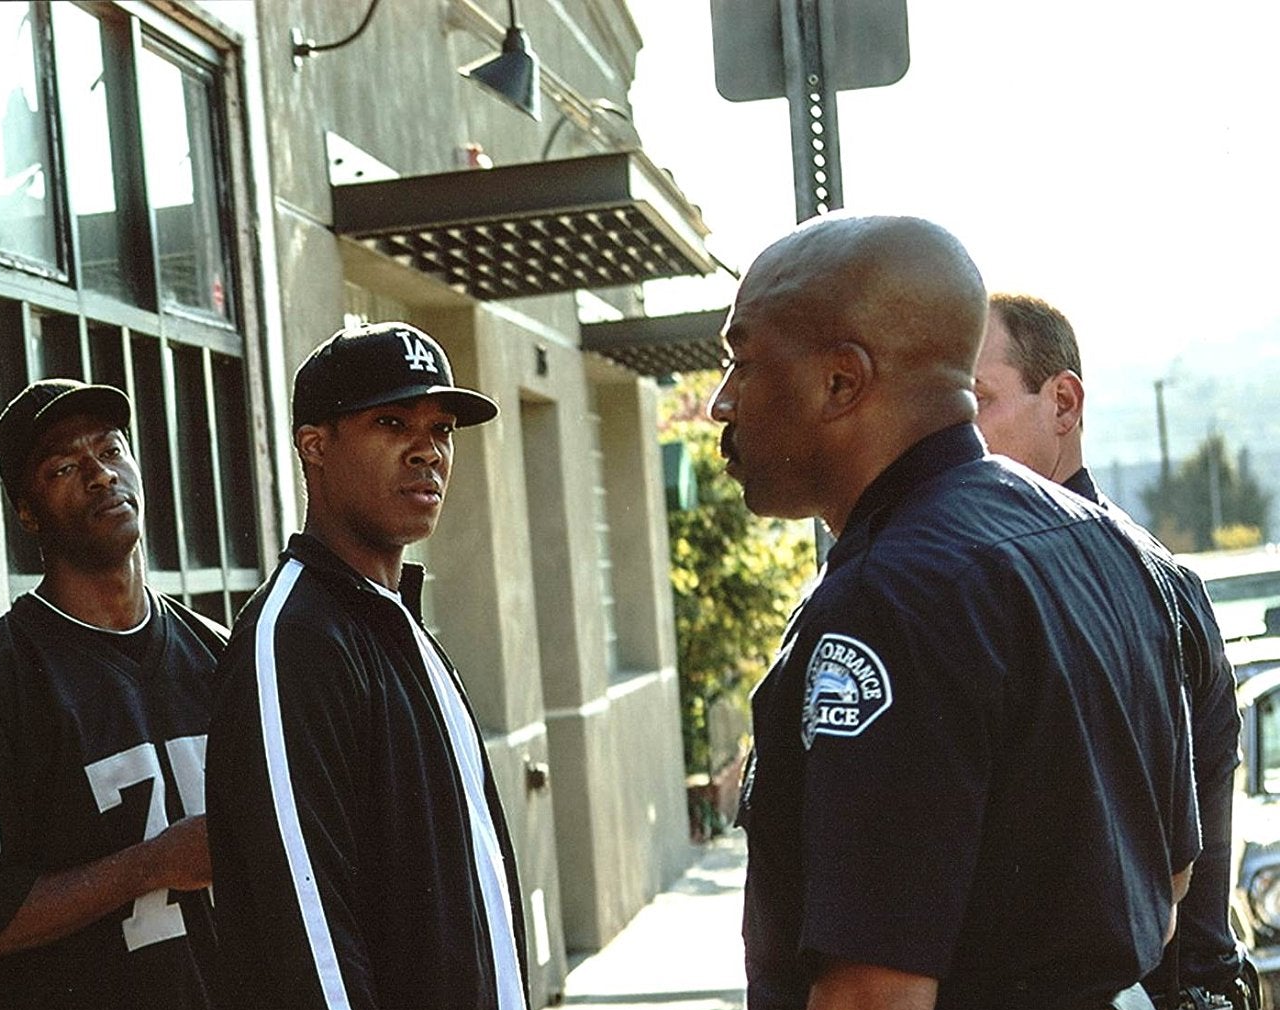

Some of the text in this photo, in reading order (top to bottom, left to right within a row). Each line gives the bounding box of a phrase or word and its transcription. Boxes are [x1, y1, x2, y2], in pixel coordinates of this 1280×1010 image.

[395, 332, 438, 373] LA
[820, 641, 883, 701] ORRANCE
[818, 706, 860, 726] ICE
